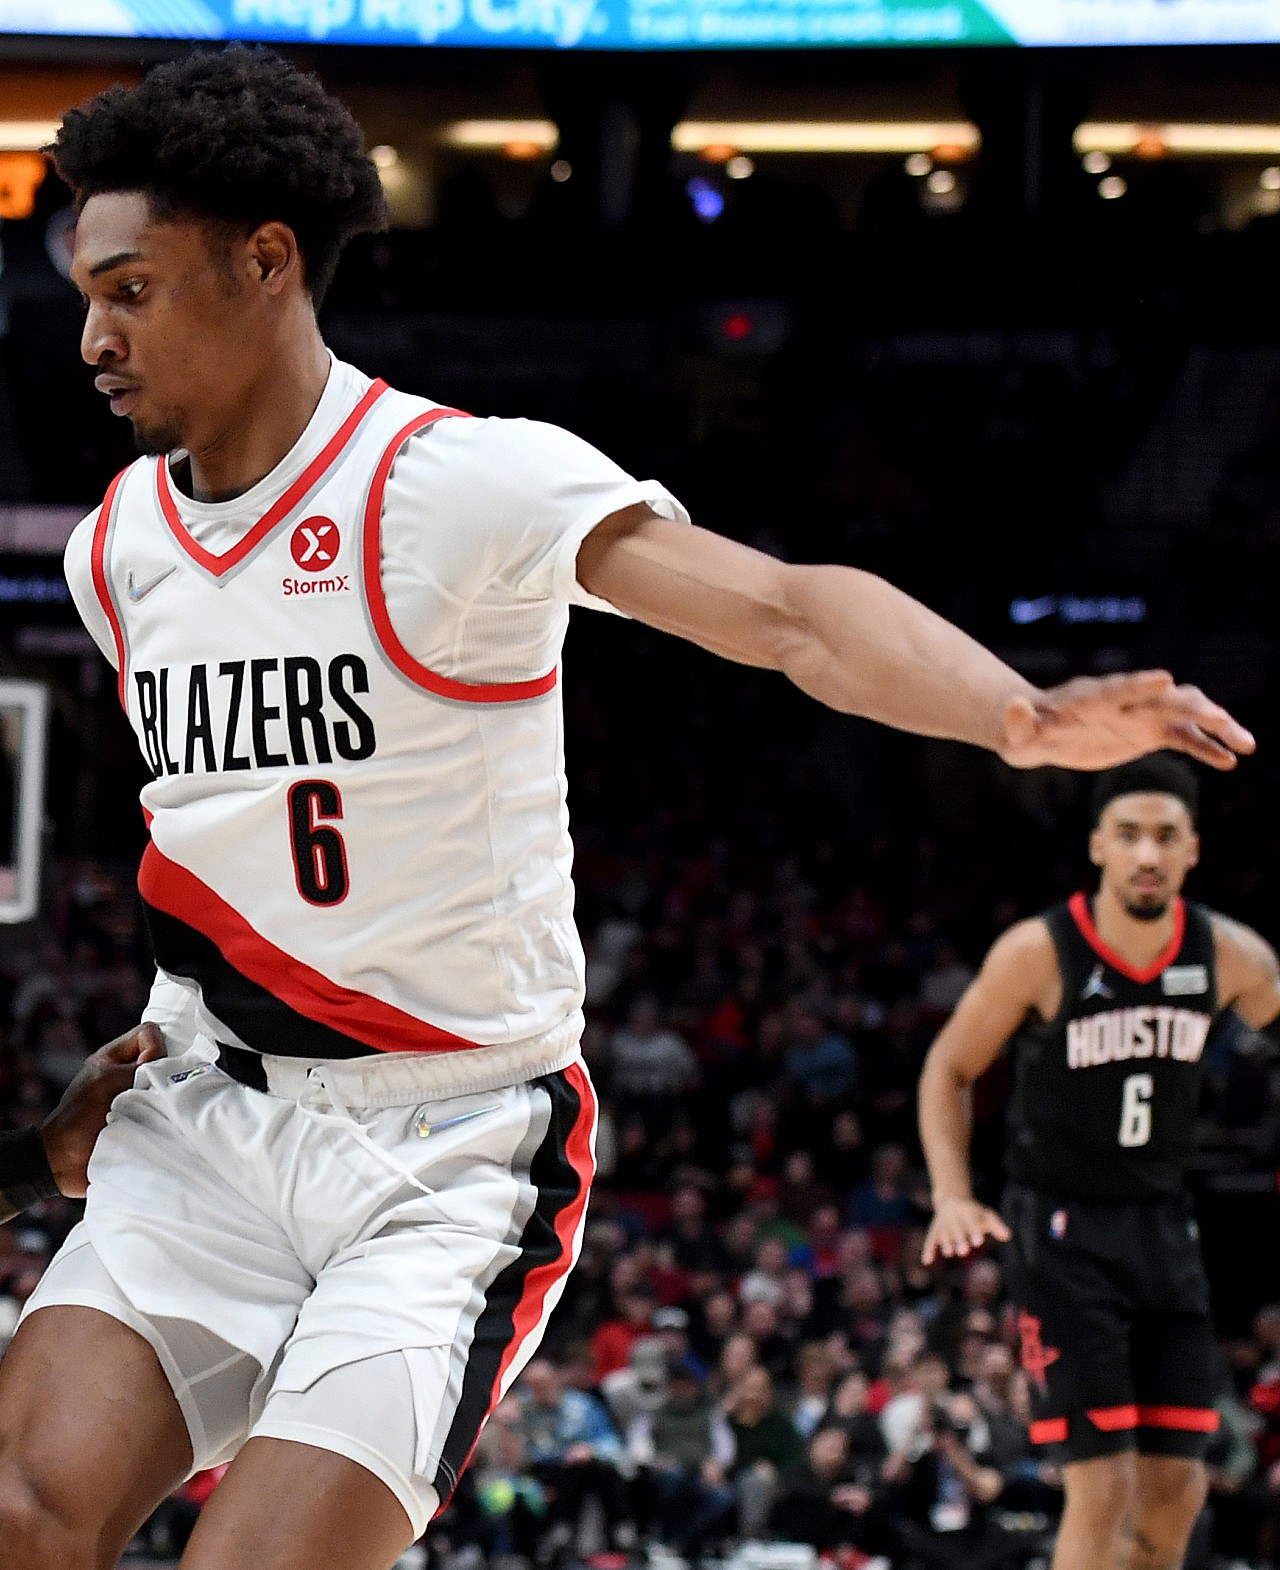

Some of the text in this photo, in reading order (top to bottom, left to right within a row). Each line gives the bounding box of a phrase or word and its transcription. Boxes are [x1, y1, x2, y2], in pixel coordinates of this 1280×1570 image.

[282, 575, 350, 596] StormX
[134, 653, 377, 778] BLAZERS
[287, 779, 350, 907] 6
[1066, 1005, 1211, 1069] HOUSTON
[1118, 1073, 1154, 1148] 6
